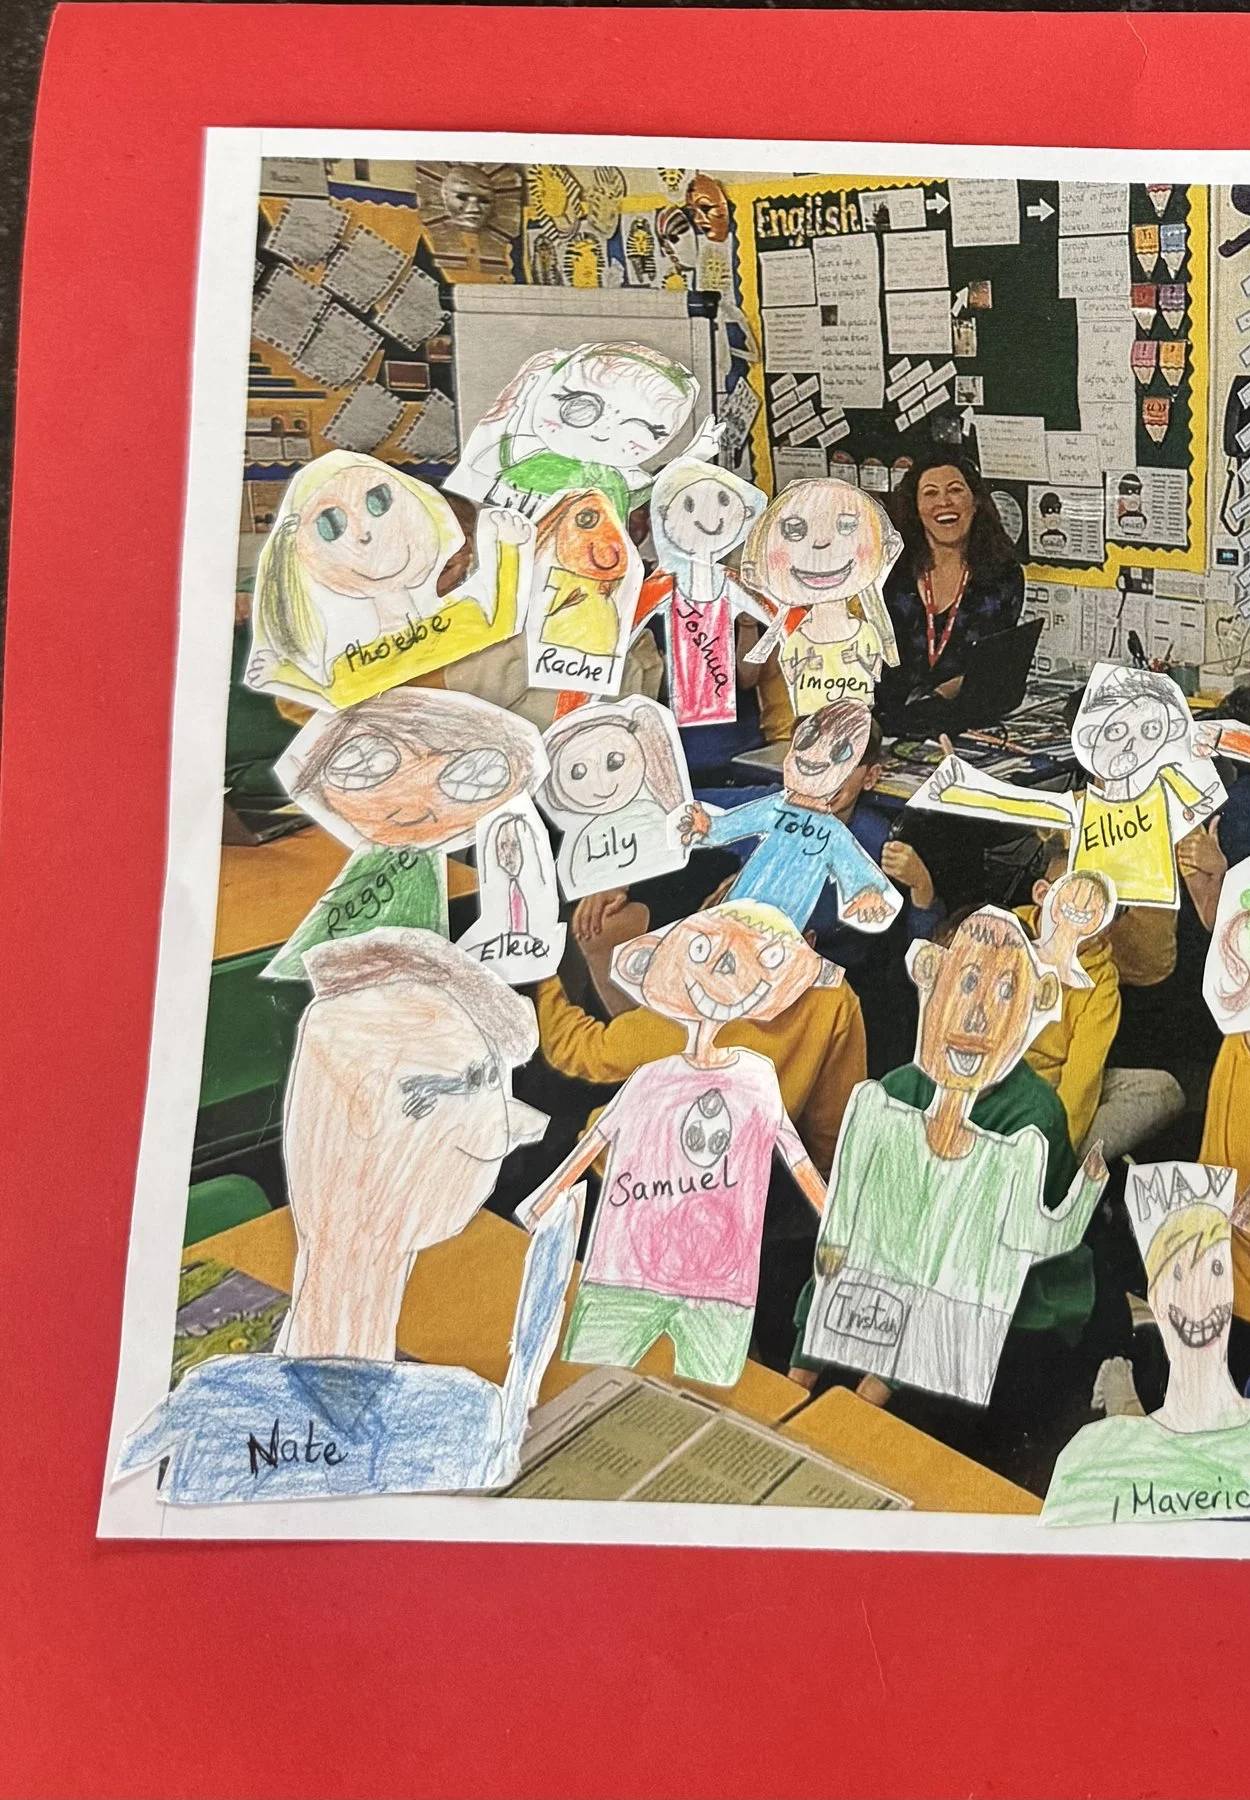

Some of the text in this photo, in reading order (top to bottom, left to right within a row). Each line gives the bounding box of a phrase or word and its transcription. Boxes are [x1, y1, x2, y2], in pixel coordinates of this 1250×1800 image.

[756, 190, 861, 247] English
[345, 612, 452, 672] Phoebe
[536, 648, 615, 684] Rachel
[676, 599, 729, 698] Joshua
[799, 673, 875, 702] Imogen
[585, 826, 639, 868] Lily
[773, 808, 835, 856] Toby
[1083, 804, 1154, 852] Elliot
[327, 849, 419, 940] Reggie
[608, 1156, 739, 1209] Samuel
[246, 1417, 351, 1478] Nate
